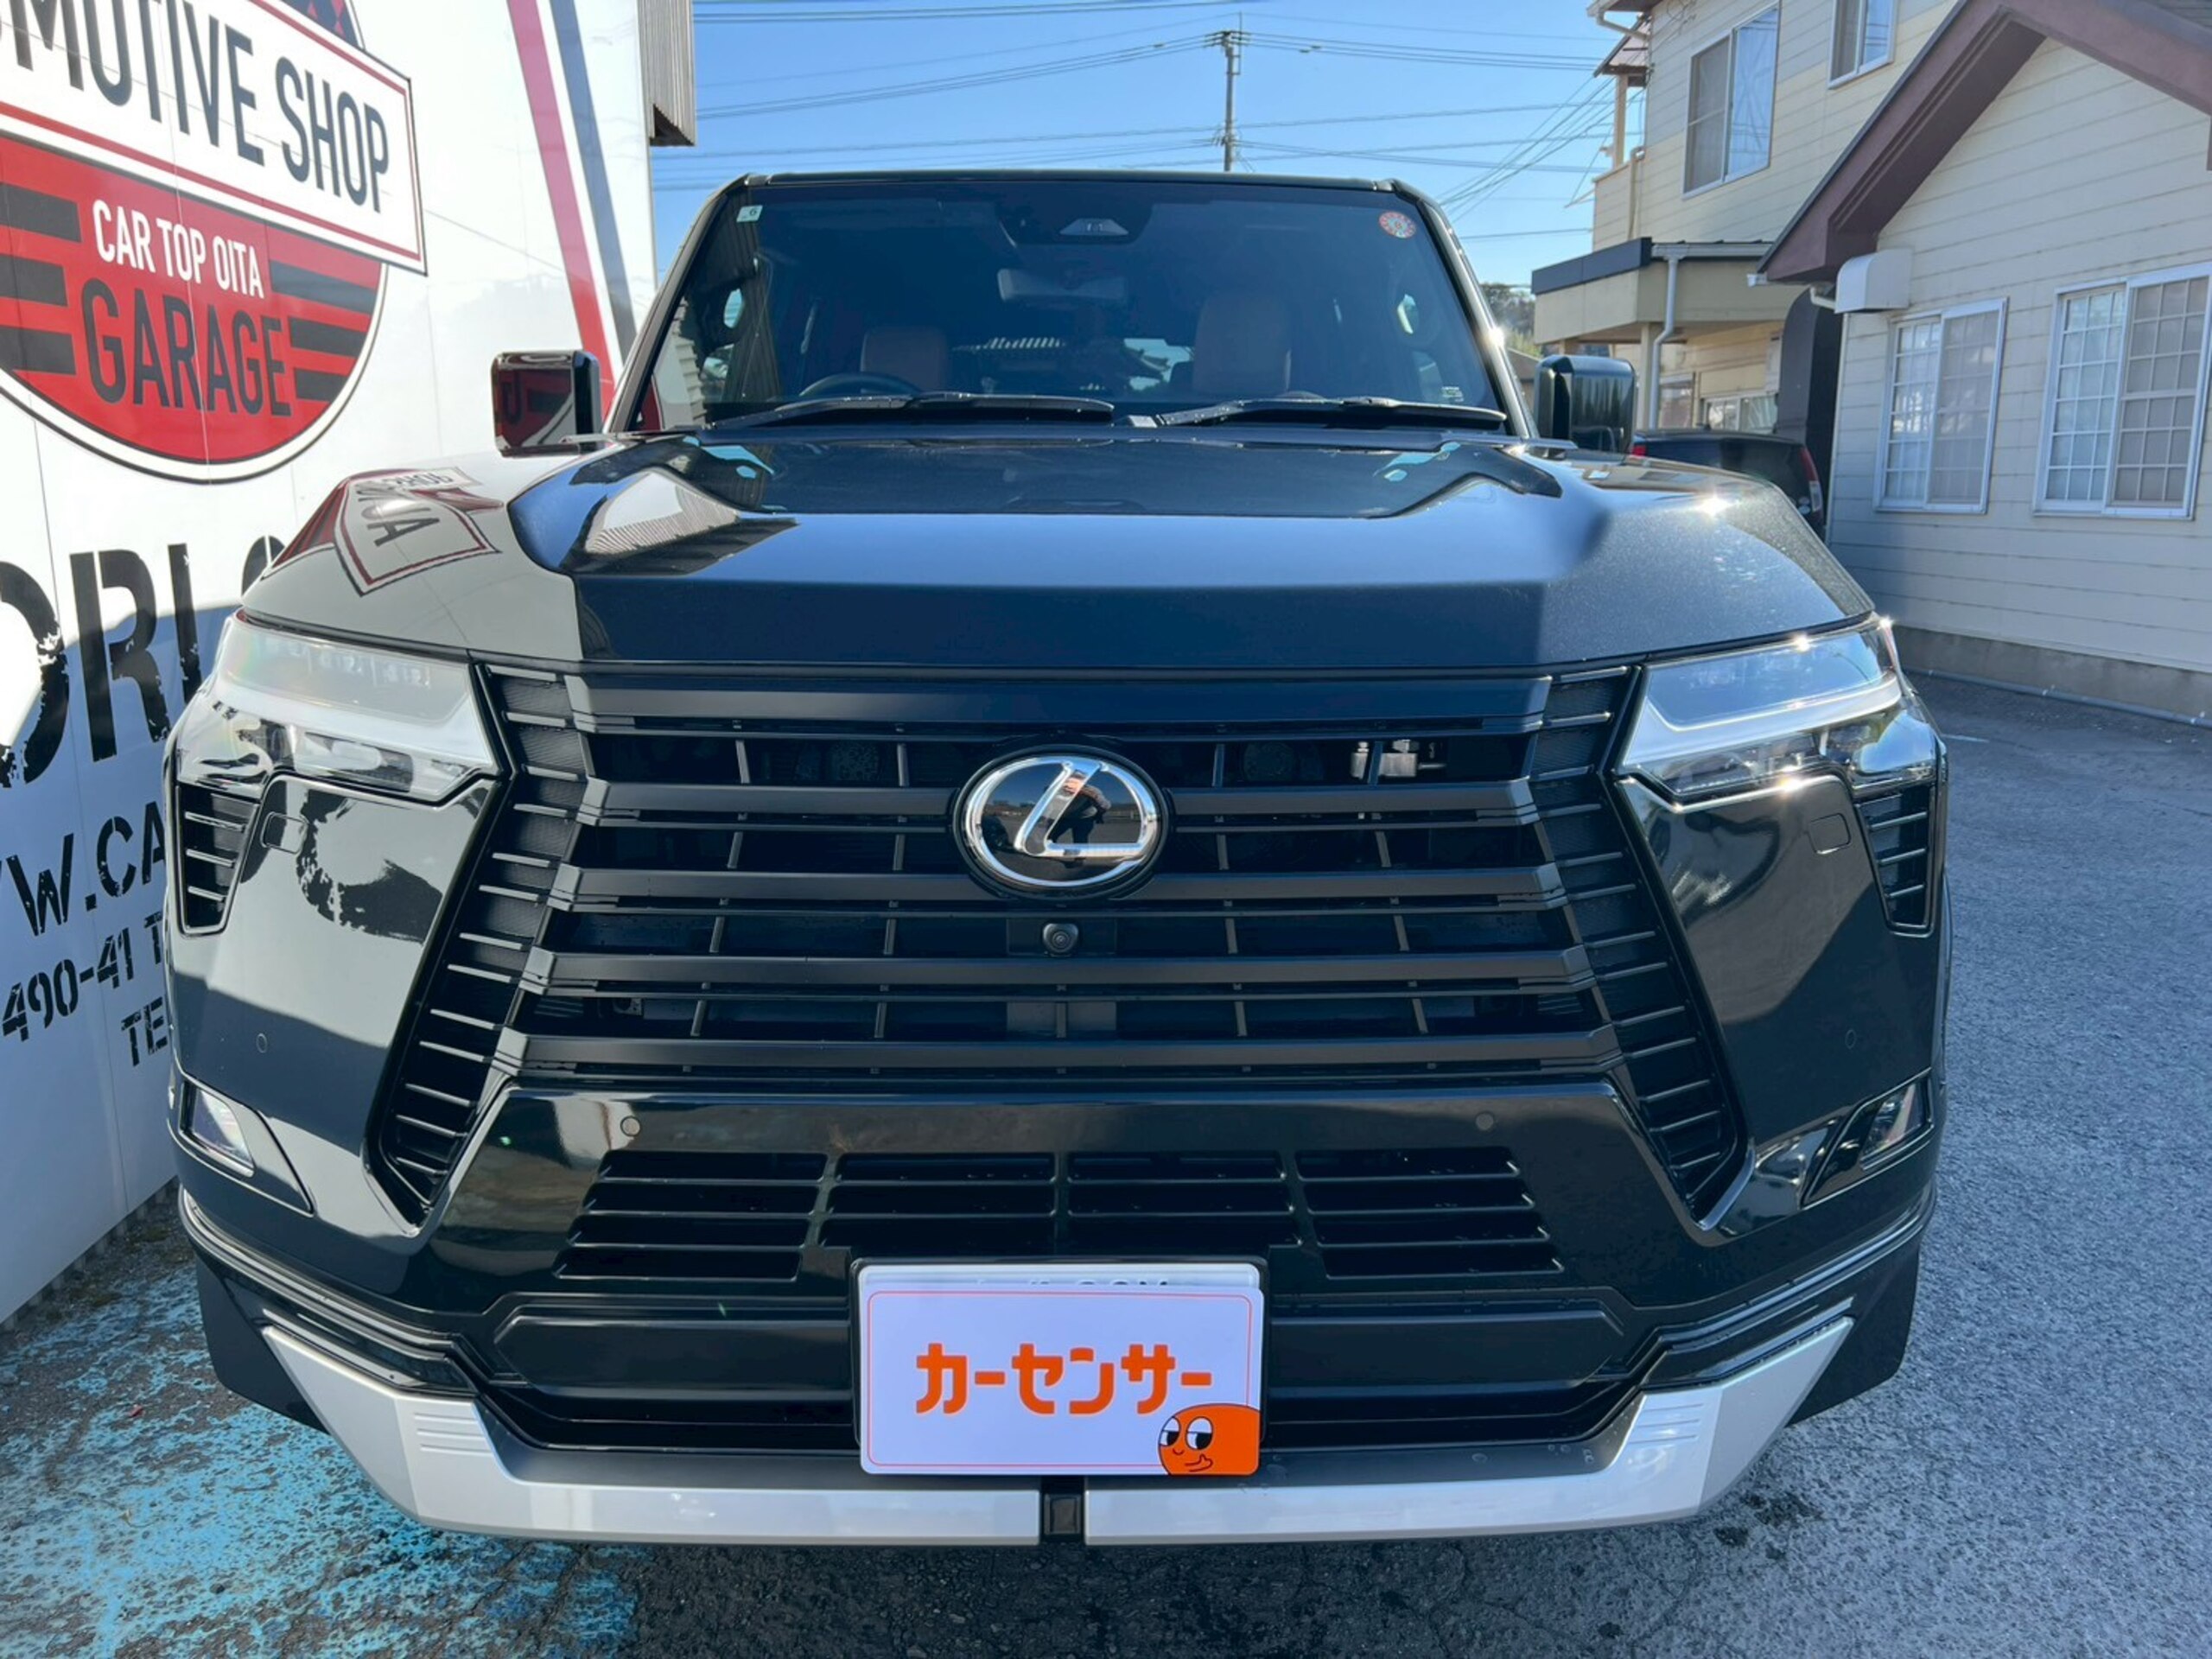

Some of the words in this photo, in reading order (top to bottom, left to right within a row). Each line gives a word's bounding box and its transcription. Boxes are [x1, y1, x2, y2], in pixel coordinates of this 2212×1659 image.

[276, 56, 389, 213] SHOP
[92, 200, 156, 273] CAR
[156, 217, 207, 284] TOP
[213, 235, 264, 299] OITA
[81, 277, 291, 417] GARAGE
[915, 1342, 1212, 1414] カーセンサー
